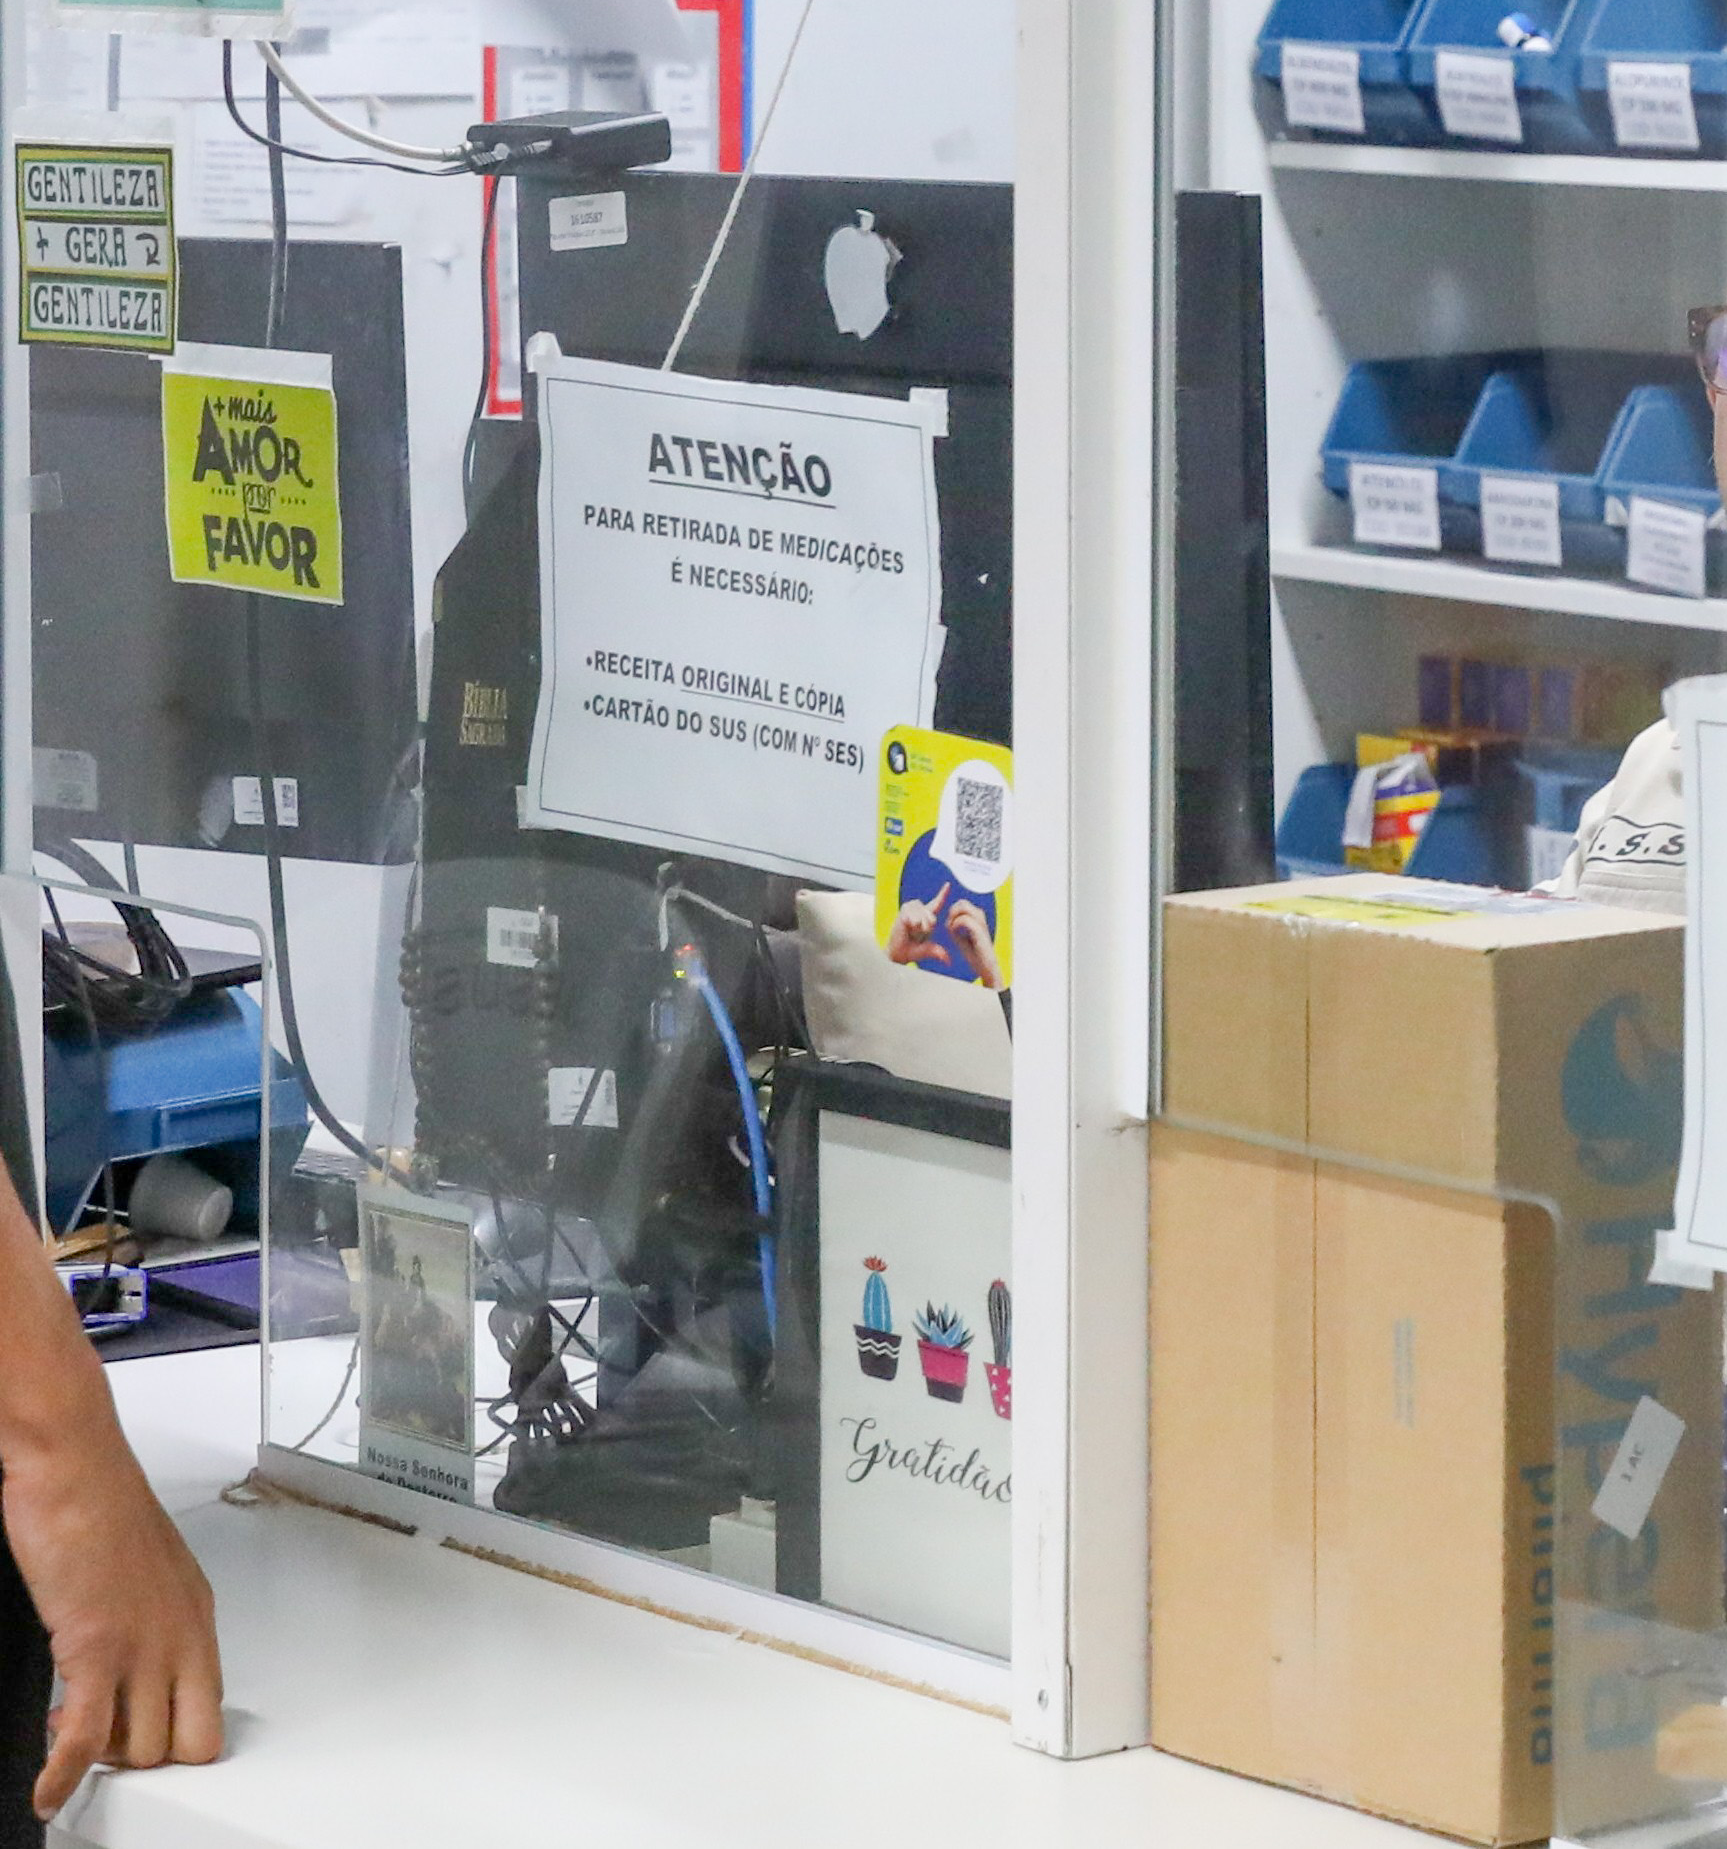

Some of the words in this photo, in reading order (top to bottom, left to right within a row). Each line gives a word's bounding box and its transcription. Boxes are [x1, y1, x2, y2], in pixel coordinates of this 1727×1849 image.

[27, 164, 160, 208] GENTILEZA
[64, 225, 128, 268] GERA
[33, 283, 164, 334] GENTILEZA
[191, 393, 314, 489] AMOR
[648, 431, 832, 499] ATENÇÃO
[201, 511, 322, 589] FAVOR
[584, 504, 635, 532] PARA
[642, 515, 742, 549] RETIRADA
[748, 527, 773, 552] DE
[780, 532, 905, 575] MEDICAÇÕES
[672, 556, 684, 584] É
[690, 564, 814, 605] NECESSÁRIO:
[681, 665, 773, 702] ORIGINAL
[779, 683, 790, 706] E
[794, 682, 846, 718] CÓPIA
[676, 709, 703, 734] DO
[710, 717, 748, 743] SUS
[753, 724, 799, 753] (COM
[824, 740, 865, 774] SES)
[367, 1446, 408, 1473] Nossa
[411, 1458, 469, 1491] Senhora
[839, 1415, 1012, 1510] Gratidão
